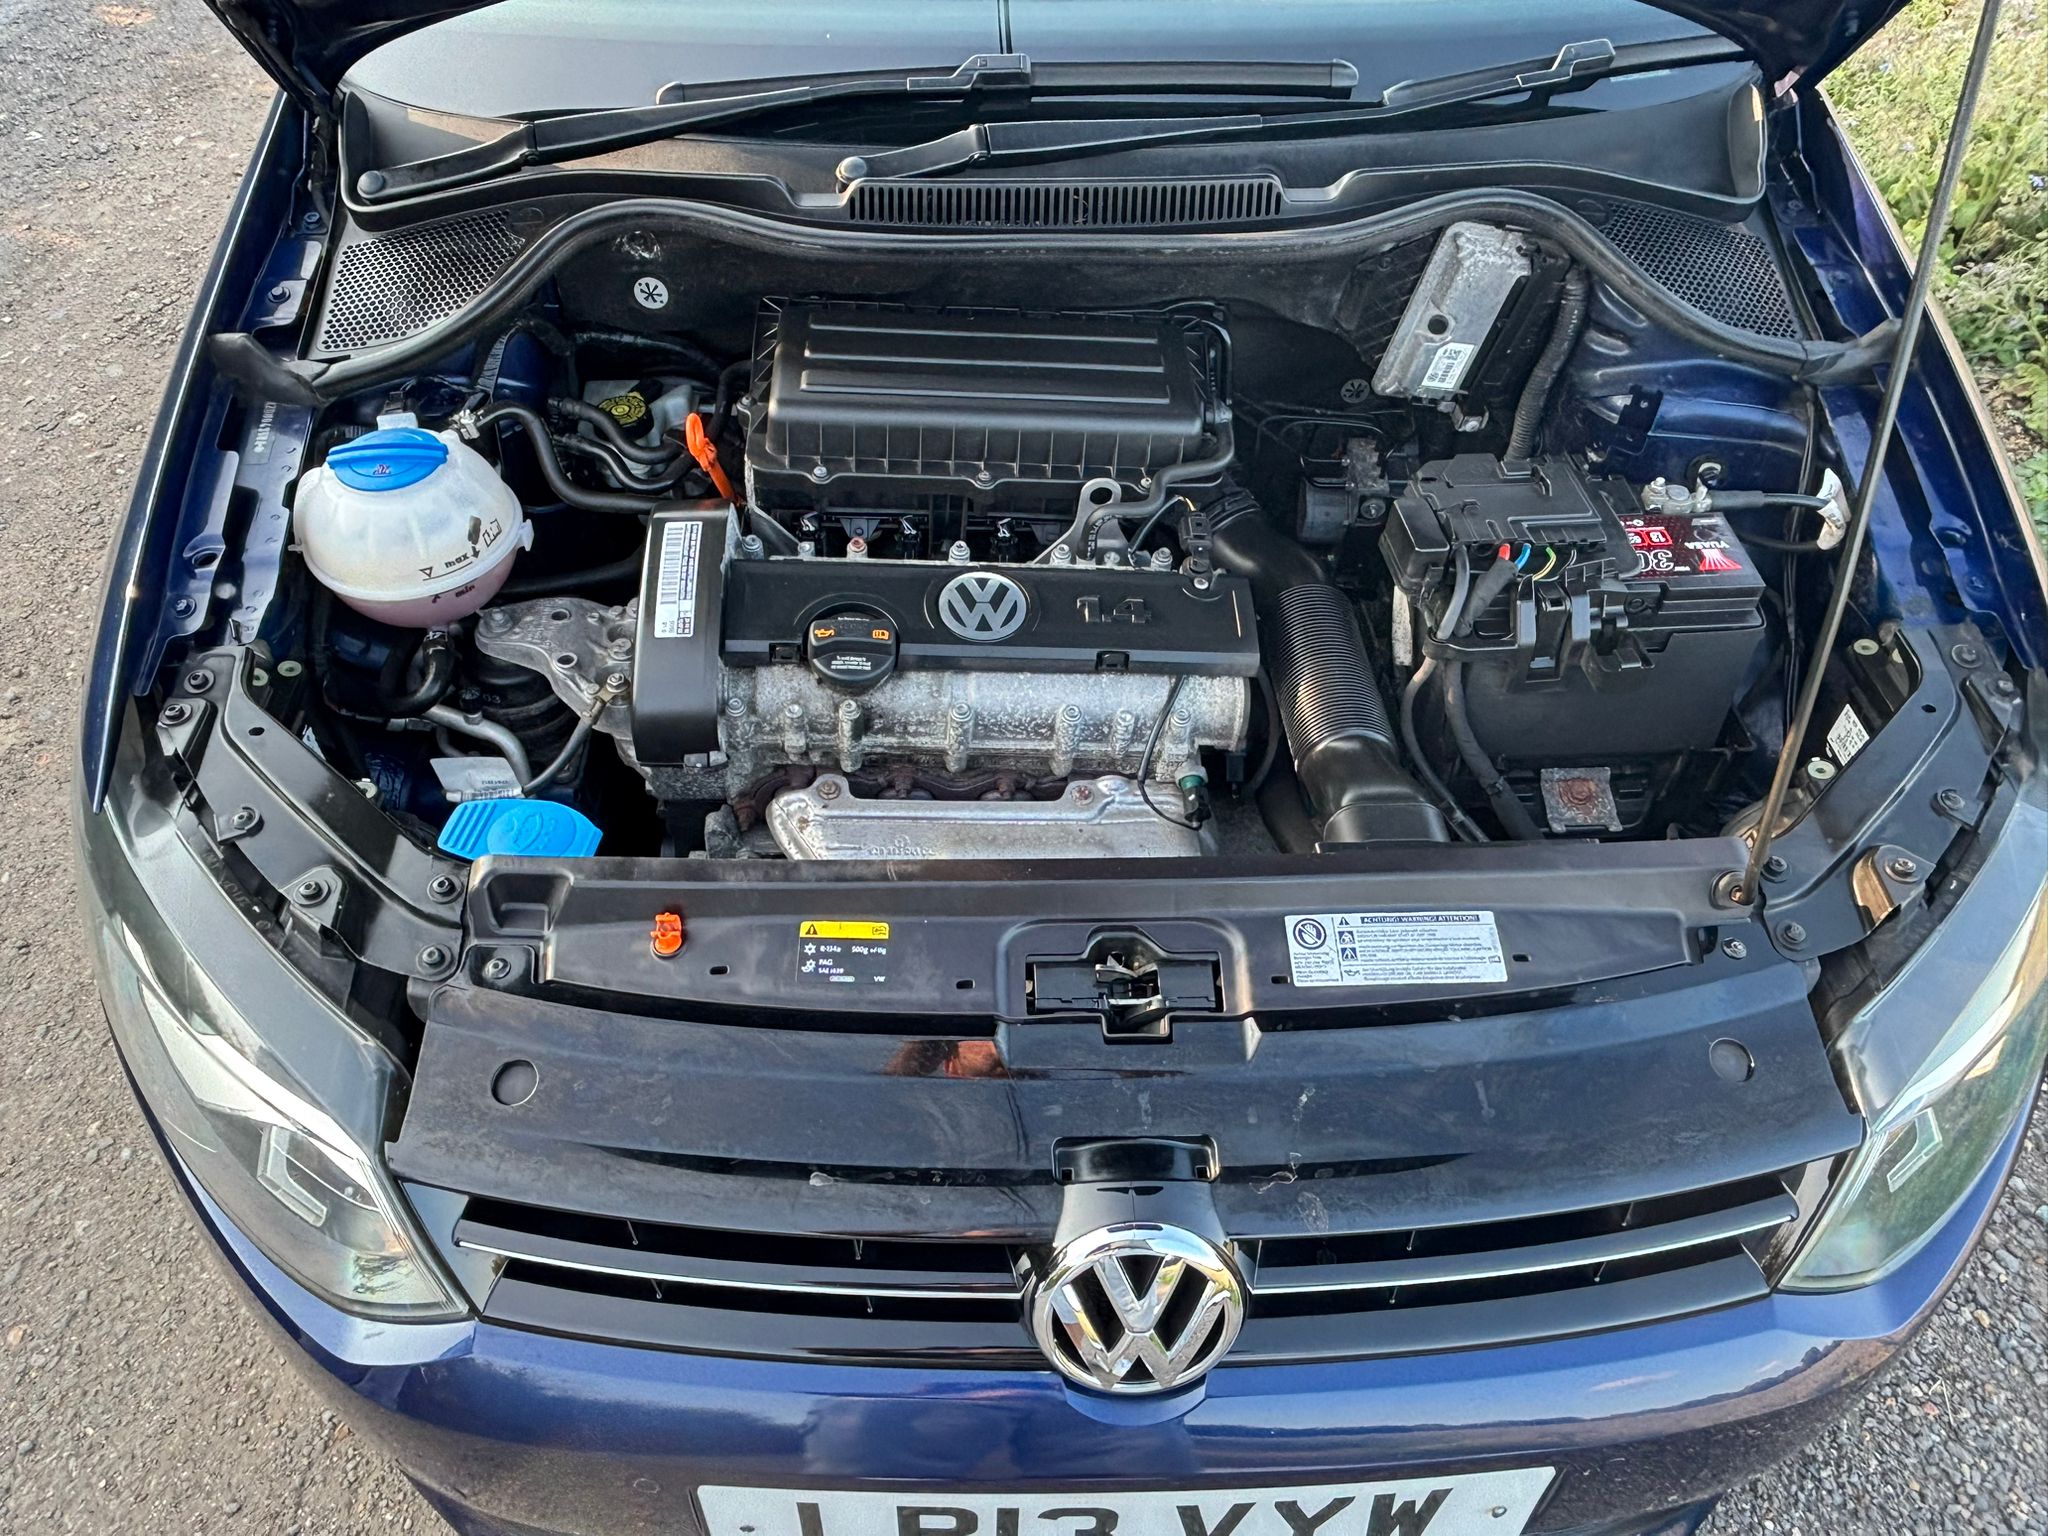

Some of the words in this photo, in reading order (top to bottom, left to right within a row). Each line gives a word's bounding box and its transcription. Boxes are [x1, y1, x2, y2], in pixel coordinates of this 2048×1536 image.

[1684, 541, 1730, 549] YUASA
[444, 552, 470, 568] max
[455, 585, 476, 598] min
[944, 575, 1022, 636] VW
[1076, 596, 1147, 623] 1.4
[1044, 1248, 1234, 1389] VW
[1176, 1487, 1454, 1536] VYW
